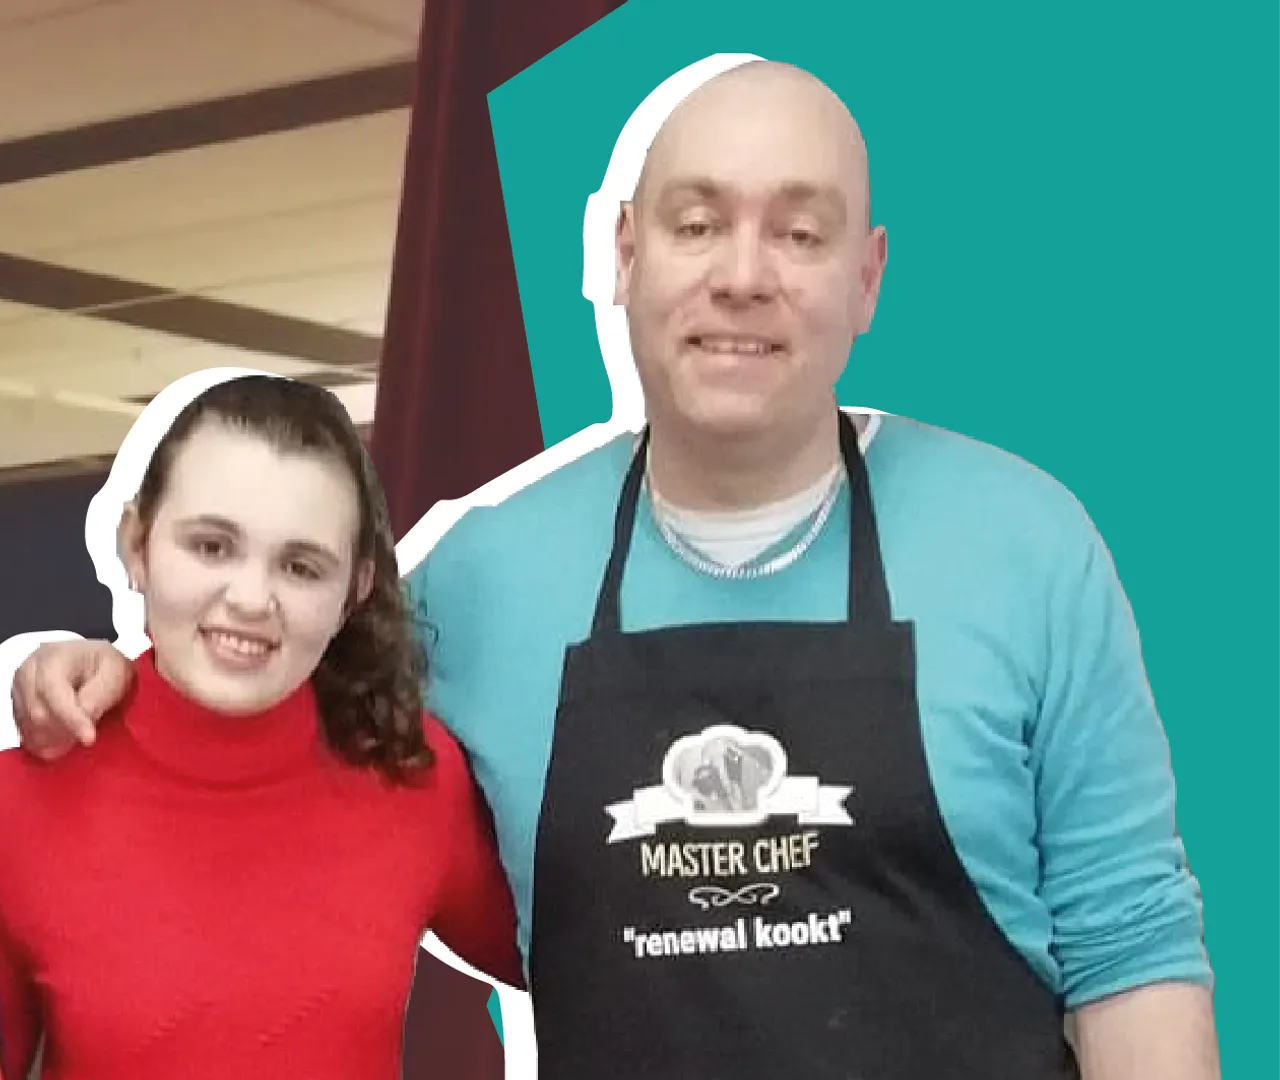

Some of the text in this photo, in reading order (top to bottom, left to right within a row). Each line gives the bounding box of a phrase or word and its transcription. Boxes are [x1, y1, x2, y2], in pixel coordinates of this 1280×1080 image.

[641, 830, 819, 878] MASTER CHEF
[623, 908, 852, 958] "renewal kookt"
